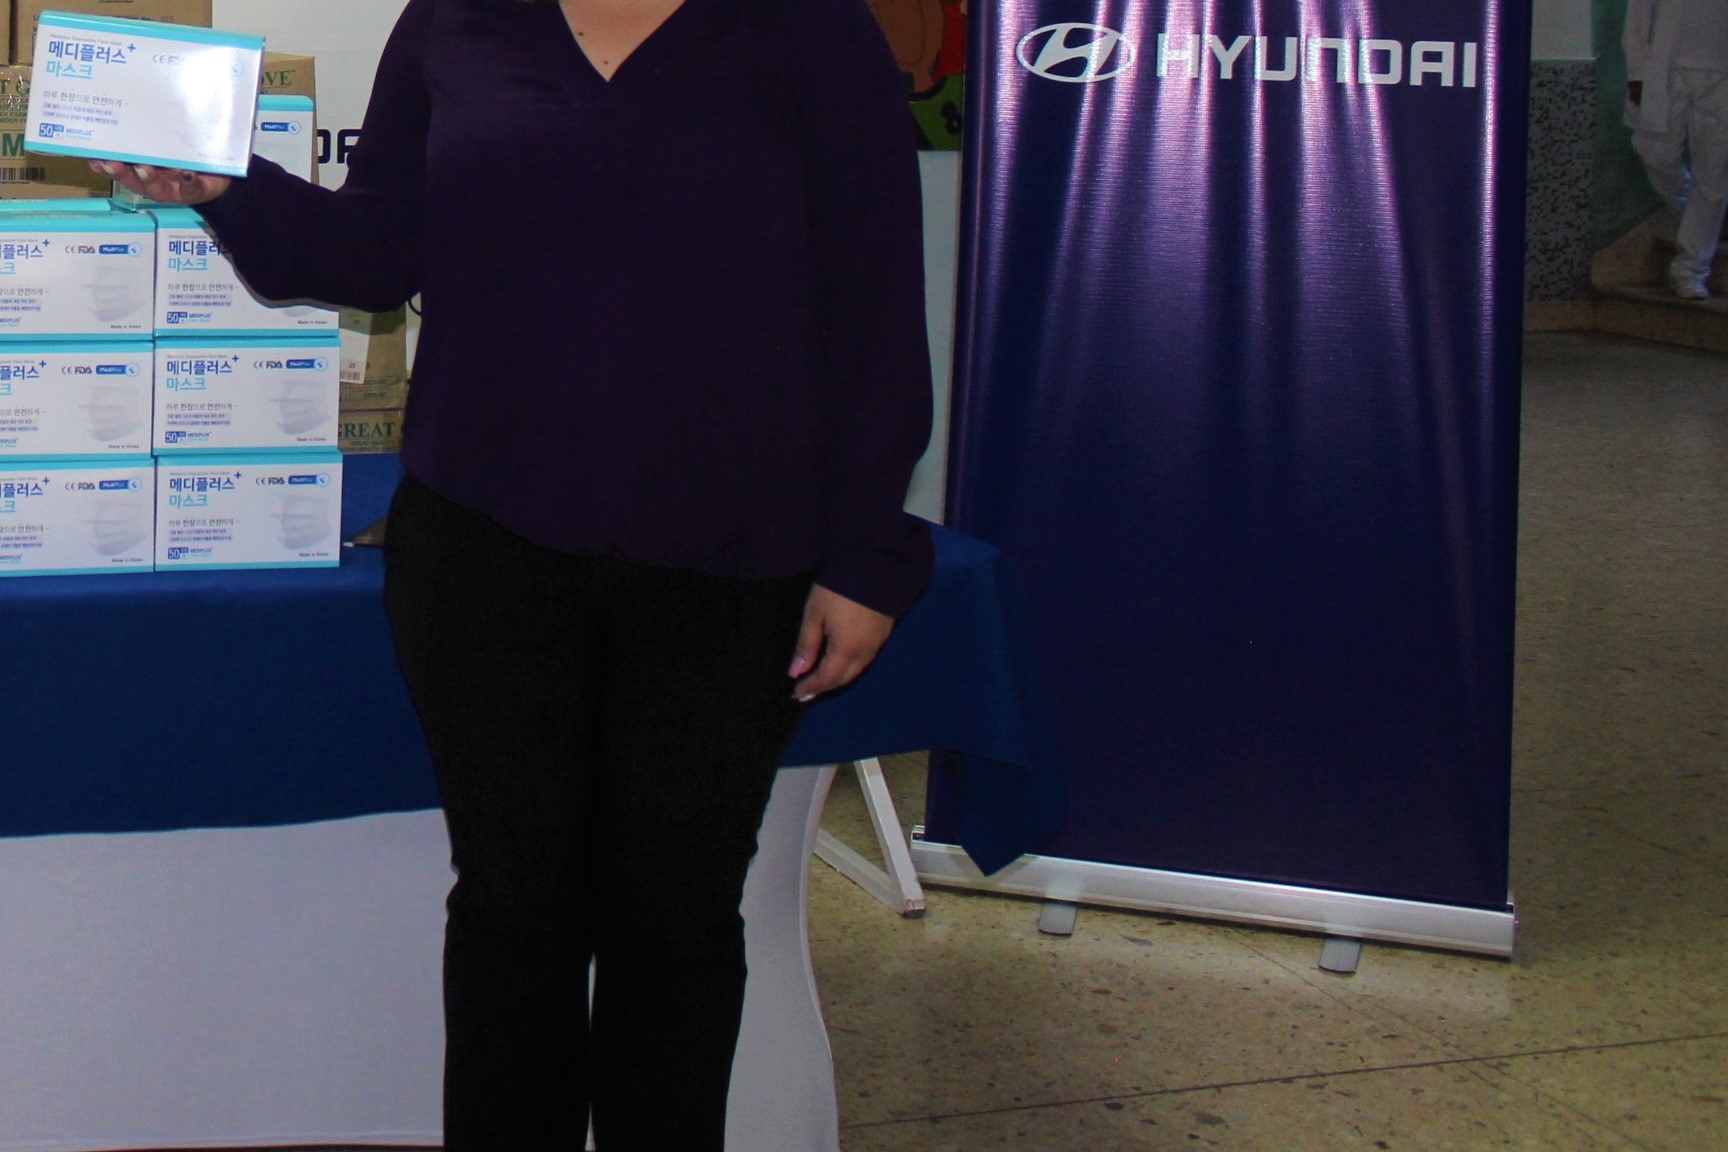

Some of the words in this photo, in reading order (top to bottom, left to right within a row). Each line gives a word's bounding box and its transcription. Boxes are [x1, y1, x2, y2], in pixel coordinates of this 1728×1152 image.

[1156, 32, 1478, 88] HYUNDAI
[46, 61, 93, 80] 마스크
[40, 124, 52, 137] 50
[2, 133, 25, 156] M
[78, 246, 95, 254] FDA
[169, 240, 222, 256] 메디플러
[169, 258, 208, 272] 마스크
[167, 313, 179, 323] 50
[75, 366, 92, 374] FDA
[266, 361, 283, 369] FDA
[166, 377, 206, 391] 마스크
[166, 432, 177, 443] 50
[78, 482, 95, 490] FDA
[268, 477, 284, 485] FDA
[169, 494, 208, 508] 마스크
[168, 548, 180, 559] 50
